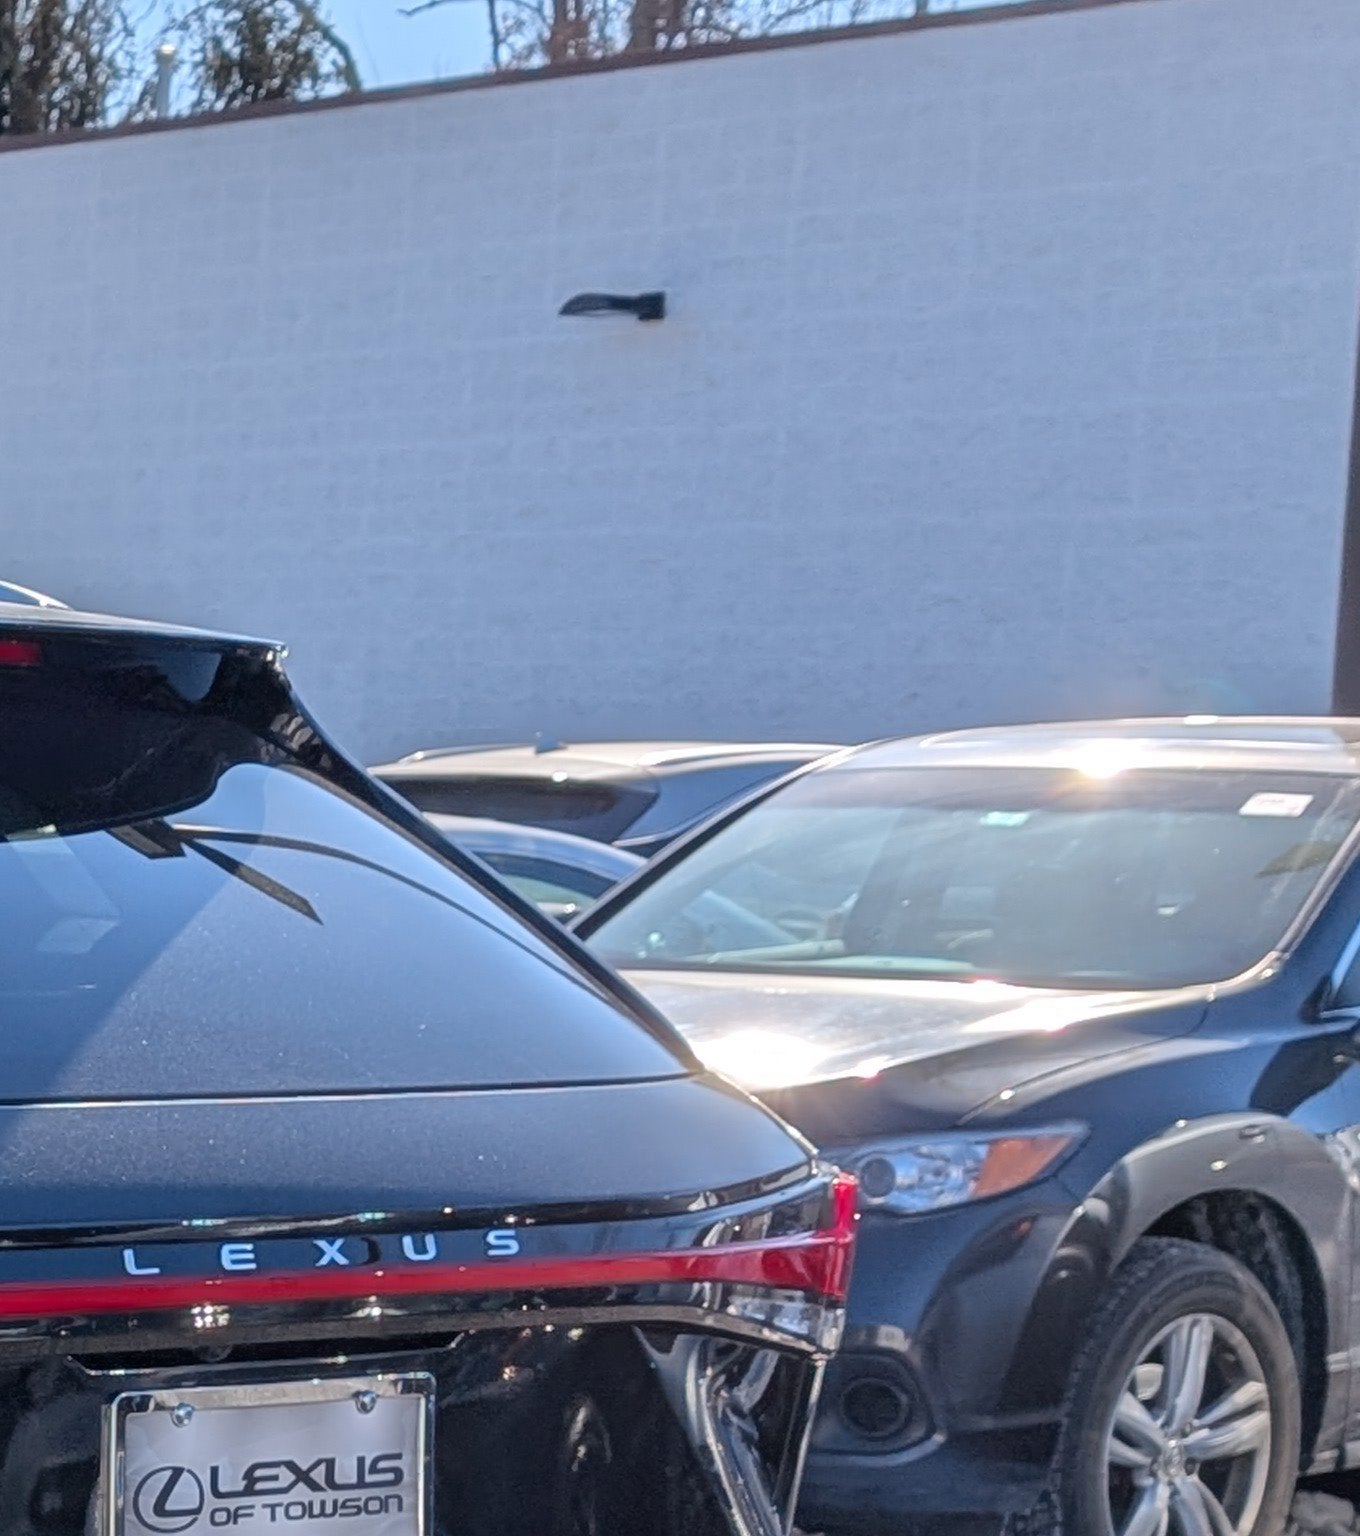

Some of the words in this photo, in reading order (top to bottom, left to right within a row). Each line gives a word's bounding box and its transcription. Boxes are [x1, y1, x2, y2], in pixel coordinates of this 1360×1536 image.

[121, 1228, 521, 1276] LEXUS
[209, 1452, 405, 1500] LEXUS
[209, 1504, 256, 1528] OF
[261, 1492, 404, 1523] TOWSON
